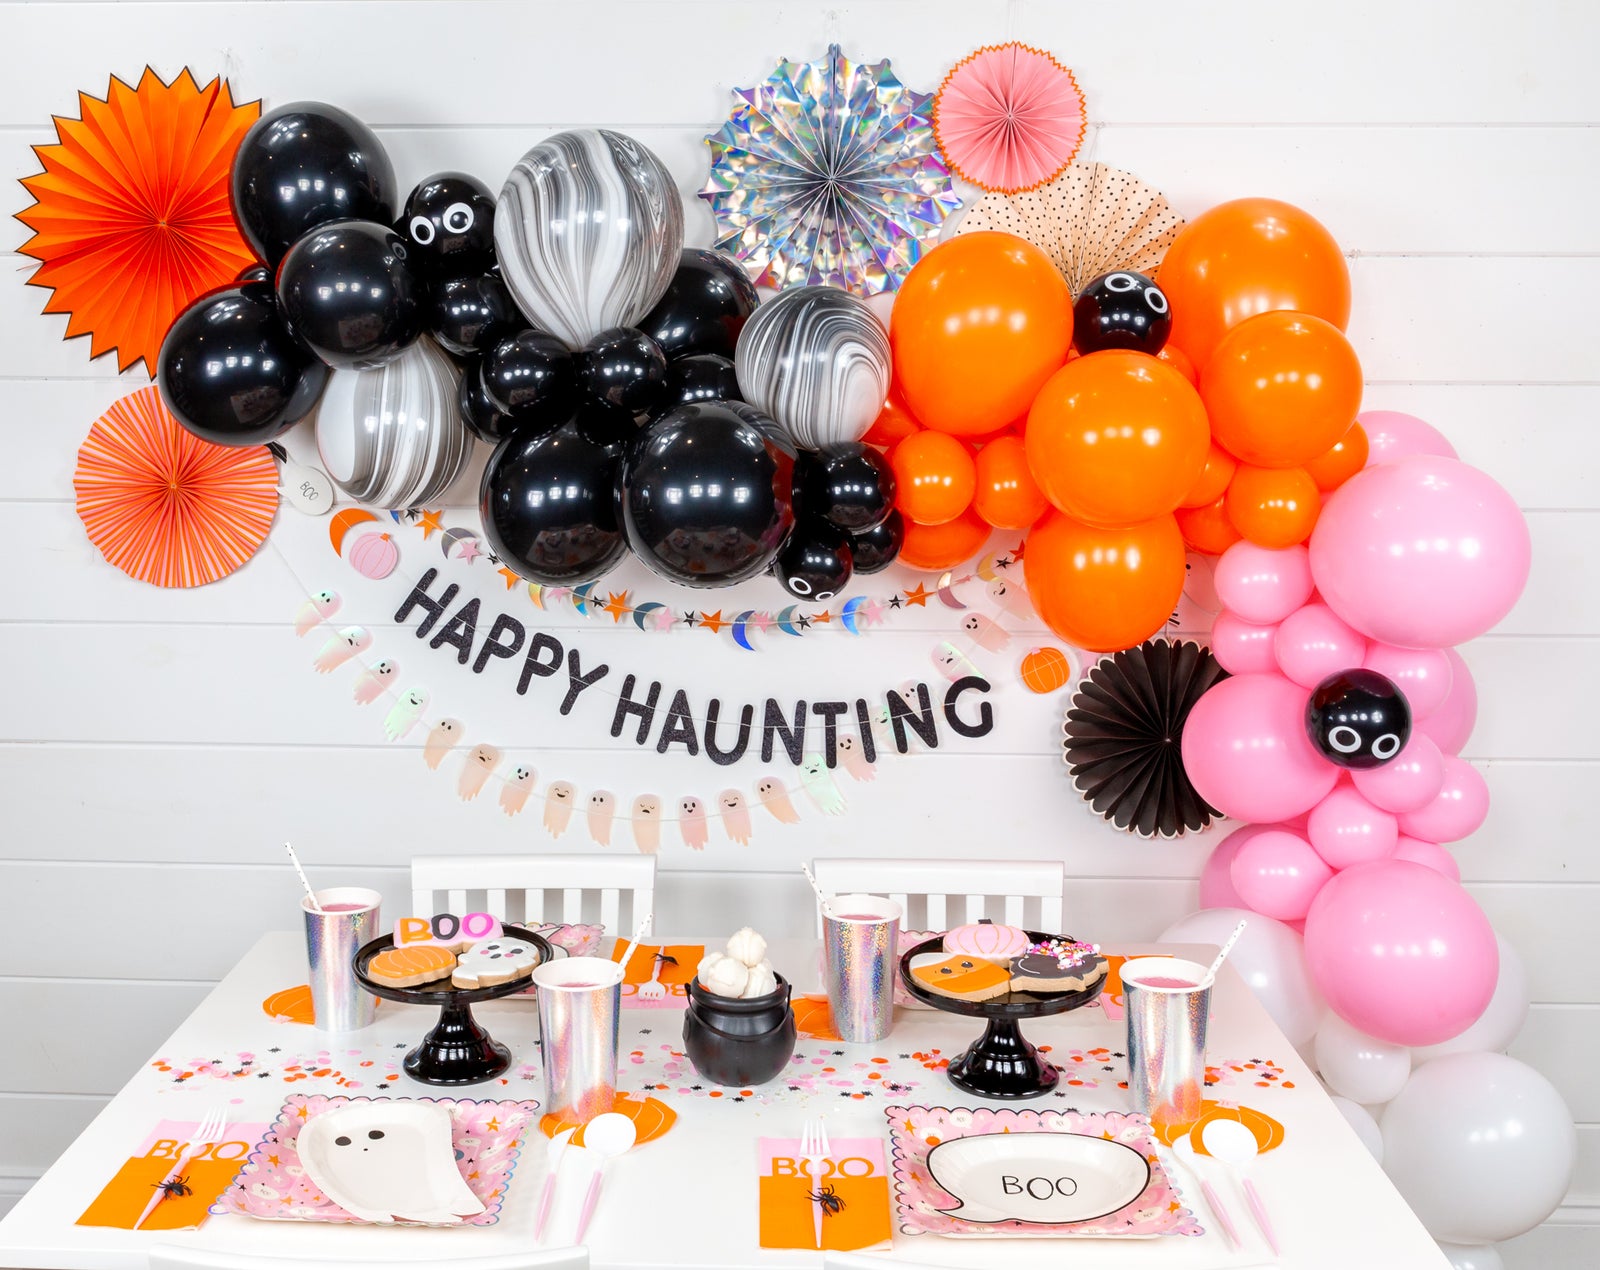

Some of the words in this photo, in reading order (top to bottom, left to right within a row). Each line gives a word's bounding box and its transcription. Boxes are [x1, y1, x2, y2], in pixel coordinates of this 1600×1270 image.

[300, 481, 318, 500] BOO
[394, 567, 609, 715] HAPPY
[610, 675, 994, 769] HAUNTING
[400, 912, 493, 944] BOO
[143, 1139, 250, 1161] BOO
[772, 1157, 874, 1178] BOO
[1002, 1175, 1077, 1200] BOO
